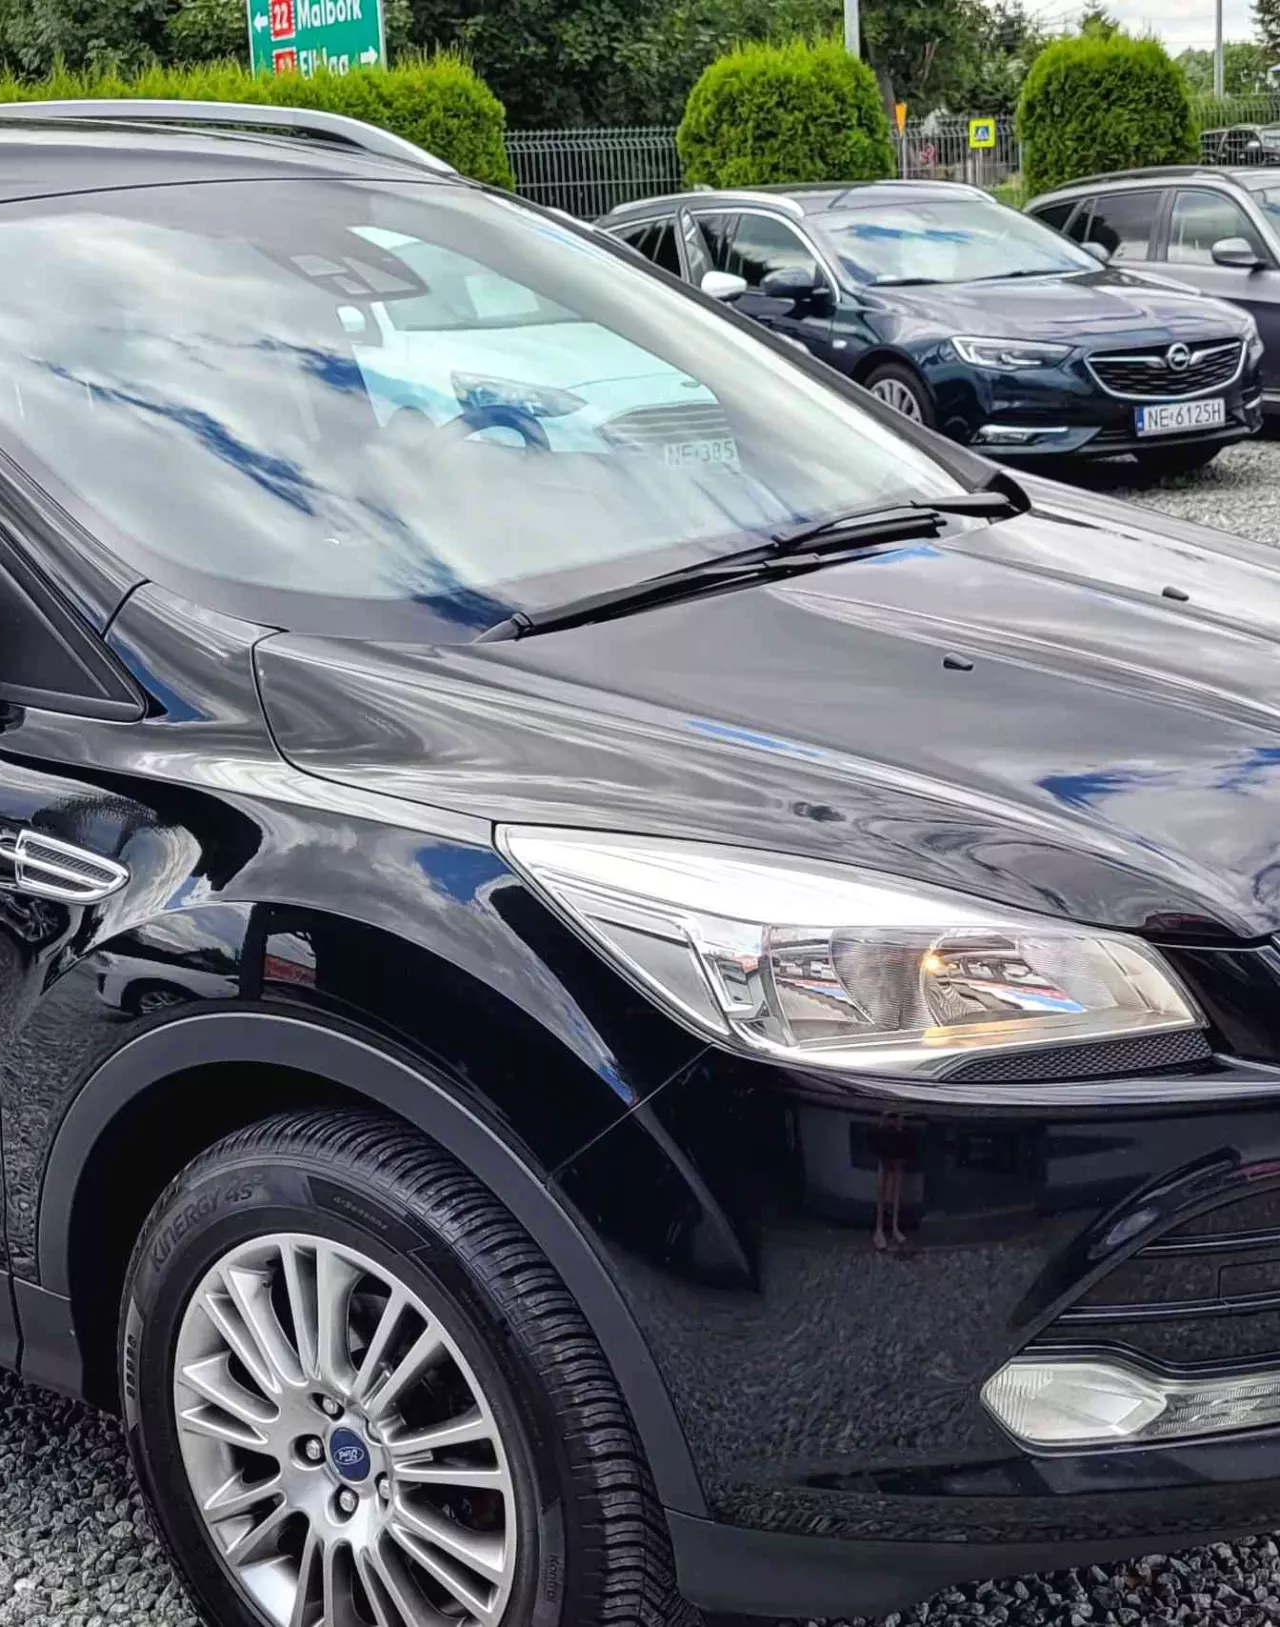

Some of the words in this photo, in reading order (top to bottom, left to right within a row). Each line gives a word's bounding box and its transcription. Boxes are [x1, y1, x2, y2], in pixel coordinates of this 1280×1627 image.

[273, 2, 289, 31] 22
[297, 0, 362, 30] Malbork
[1148, 407, 1169, 429] NE
[1176, 401, 1221, 425] 6125H
